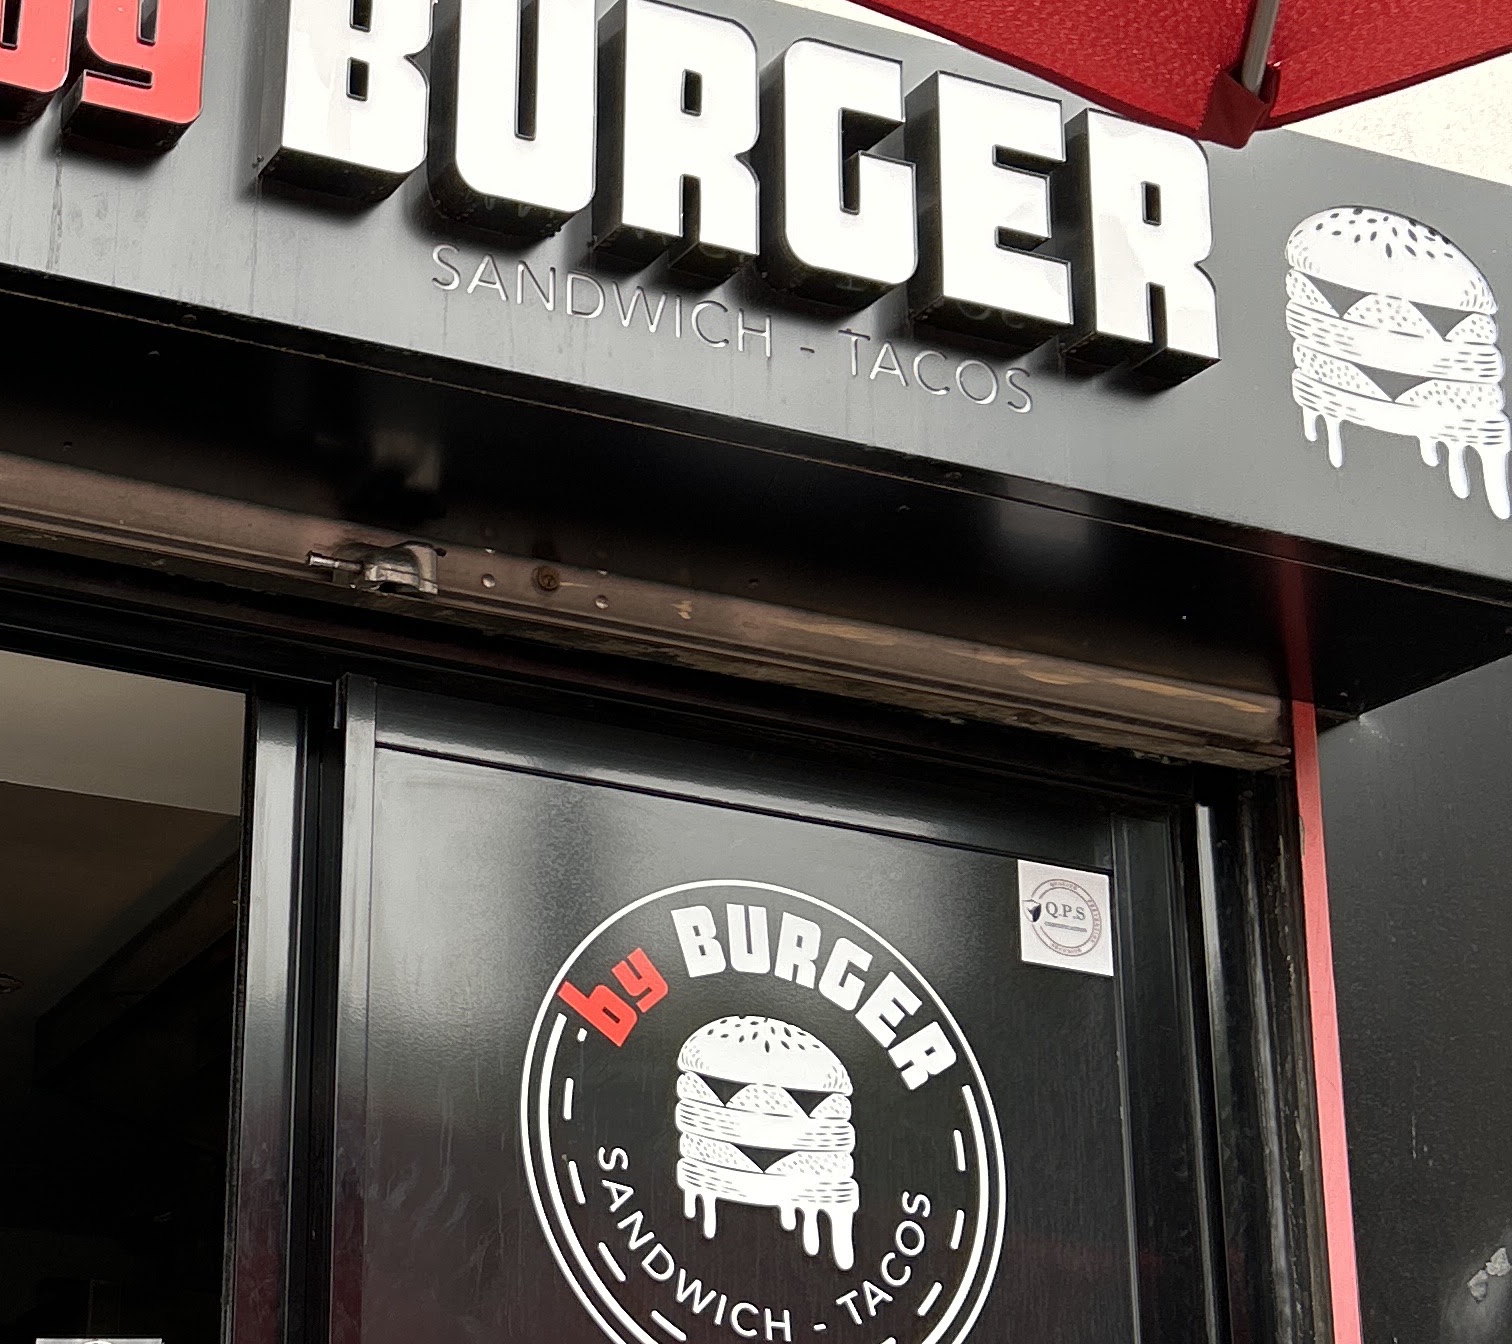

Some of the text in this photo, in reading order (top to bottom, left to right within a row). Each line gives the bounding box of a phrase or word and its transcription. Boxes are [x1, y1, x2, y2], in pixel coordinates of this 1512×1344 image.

[430, 244, 774, 358] SANDWICH
[836, 328, 1035, 416] TACOS
[556, 902, 957, 1091] by BURGER
[597, 1145, 794, 1343] SANDWICH
[835, 1190, 932, 1327] TACOS
